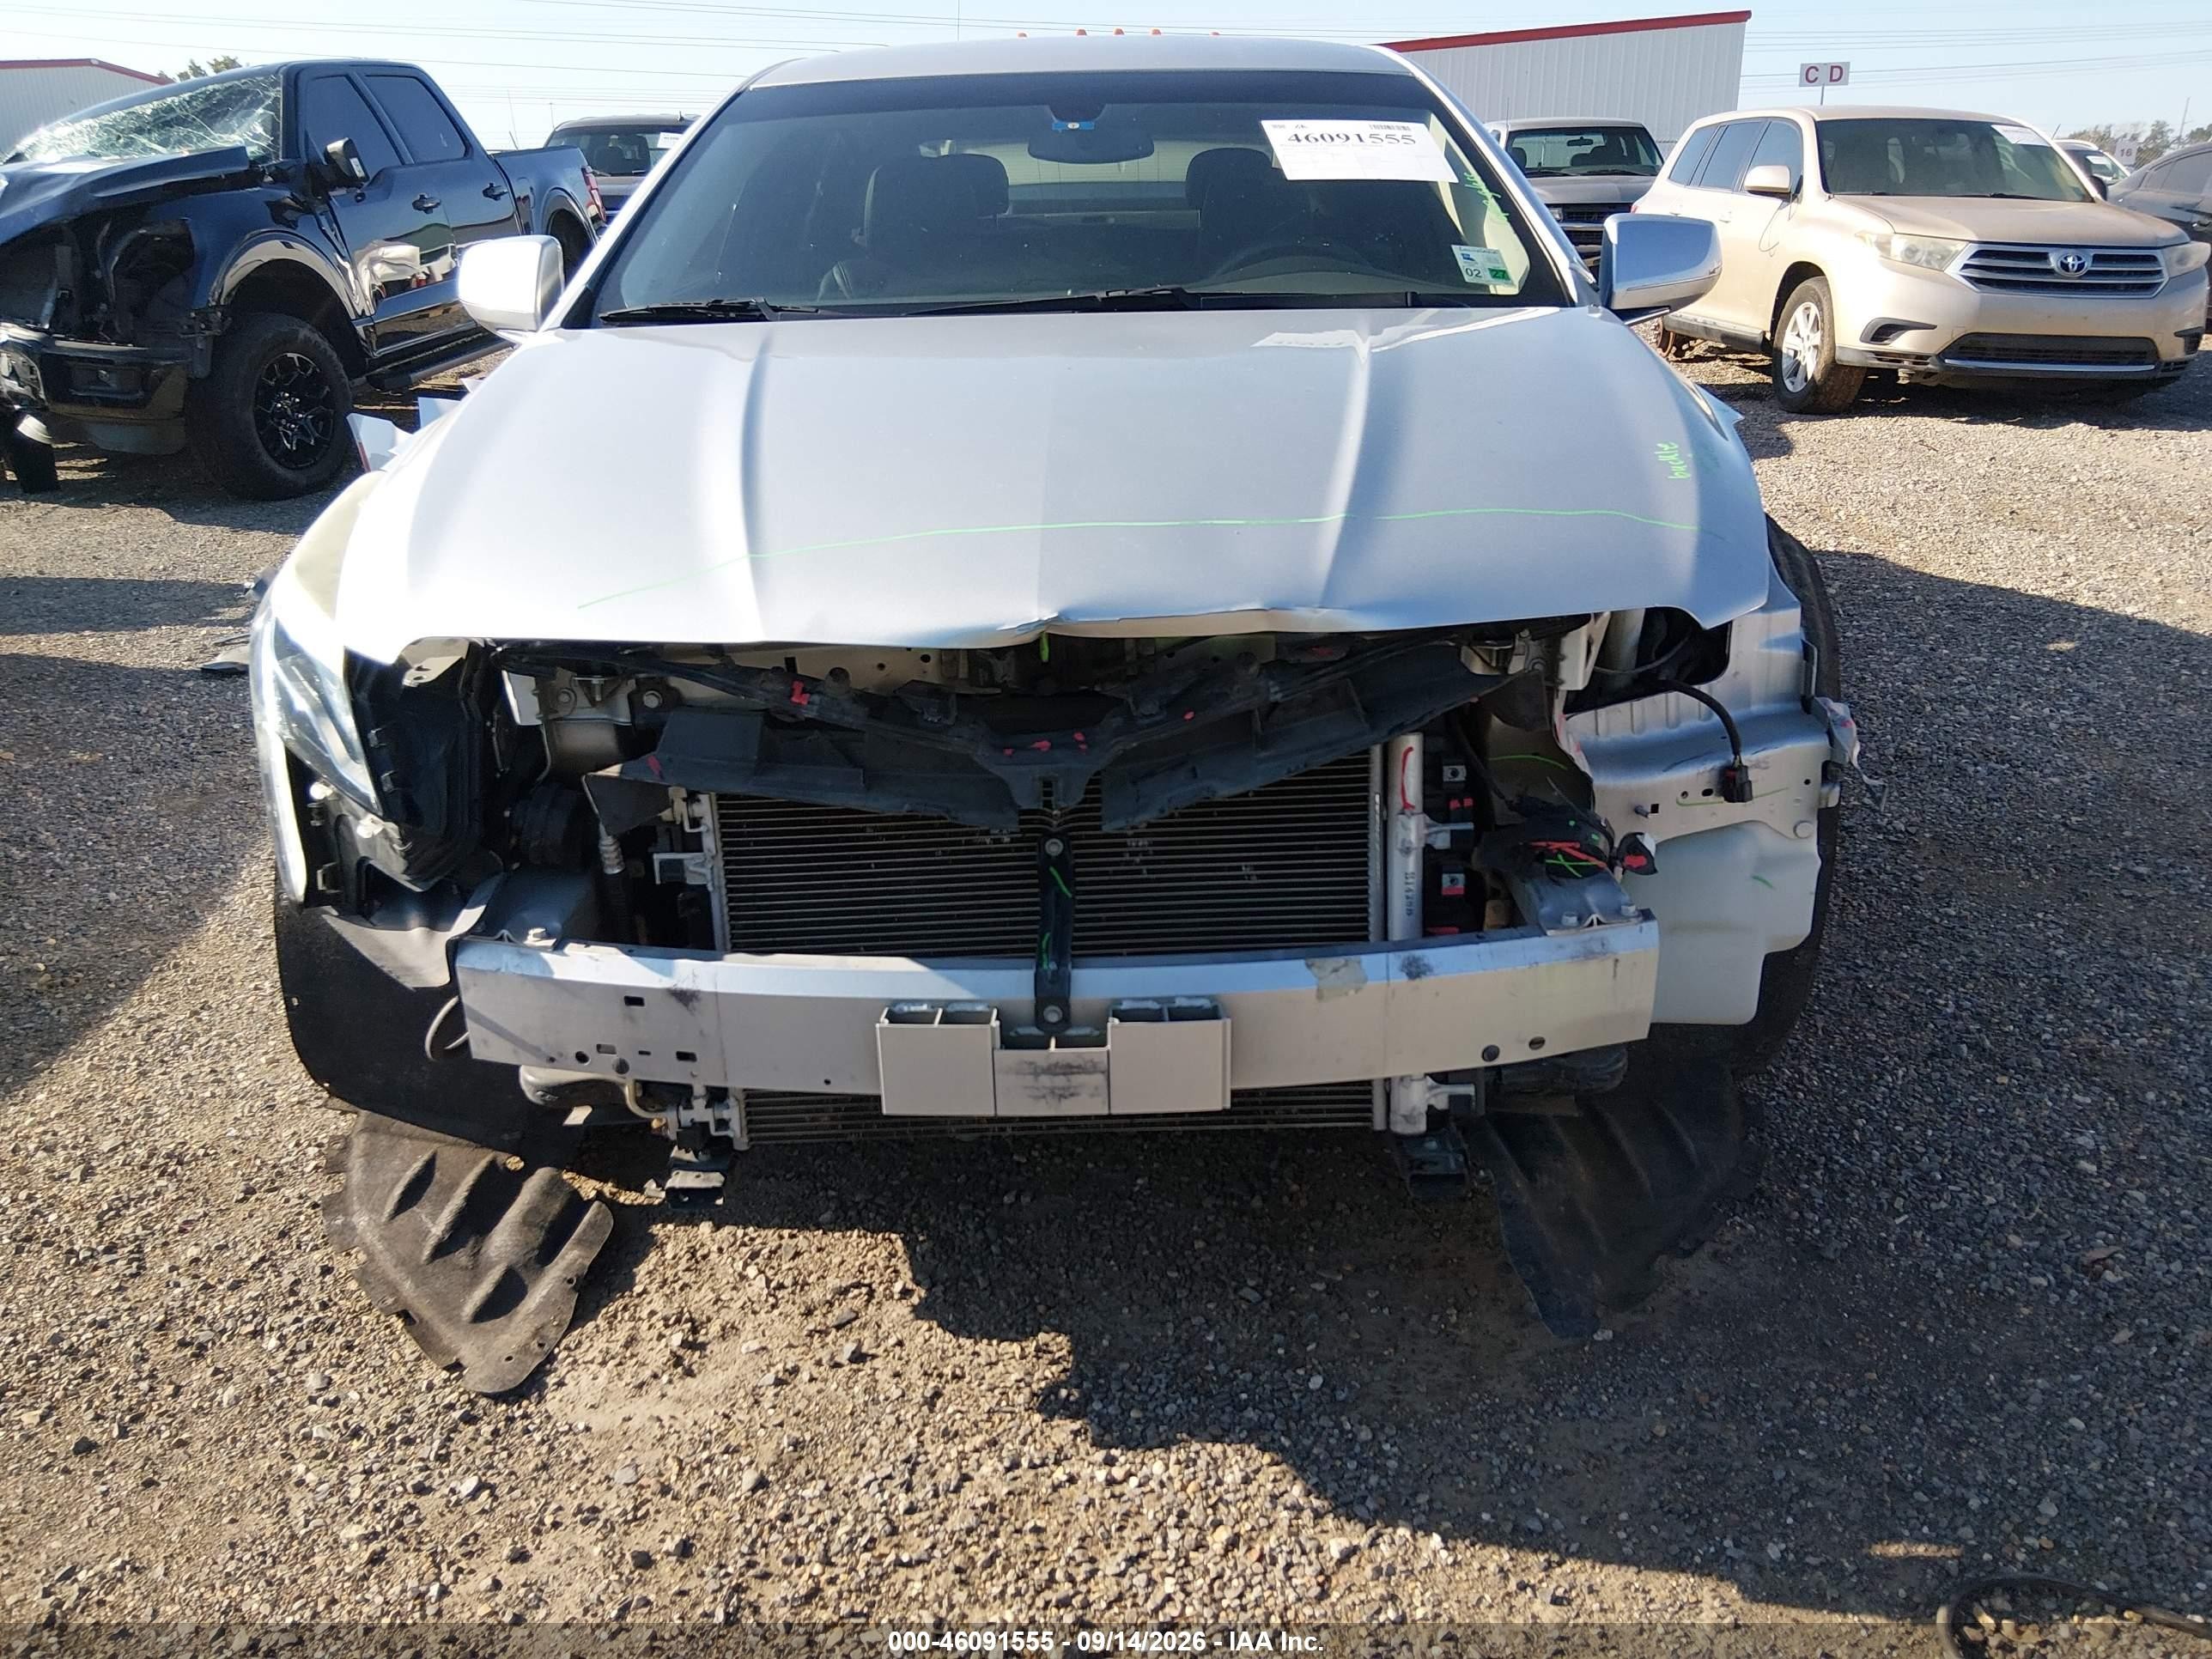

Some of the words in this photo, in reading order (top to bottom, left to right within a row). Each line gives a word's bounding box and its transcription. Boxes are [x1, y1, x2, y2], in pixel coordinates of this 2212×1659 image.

[1805, 65, 1820, 83] C
[1829, 65, 1844, 82] D
[1287, 132, 1416, 145] 46091555
[2120, 148, 2133, 157] 16
[1465, 268, 1483, 278] 02
